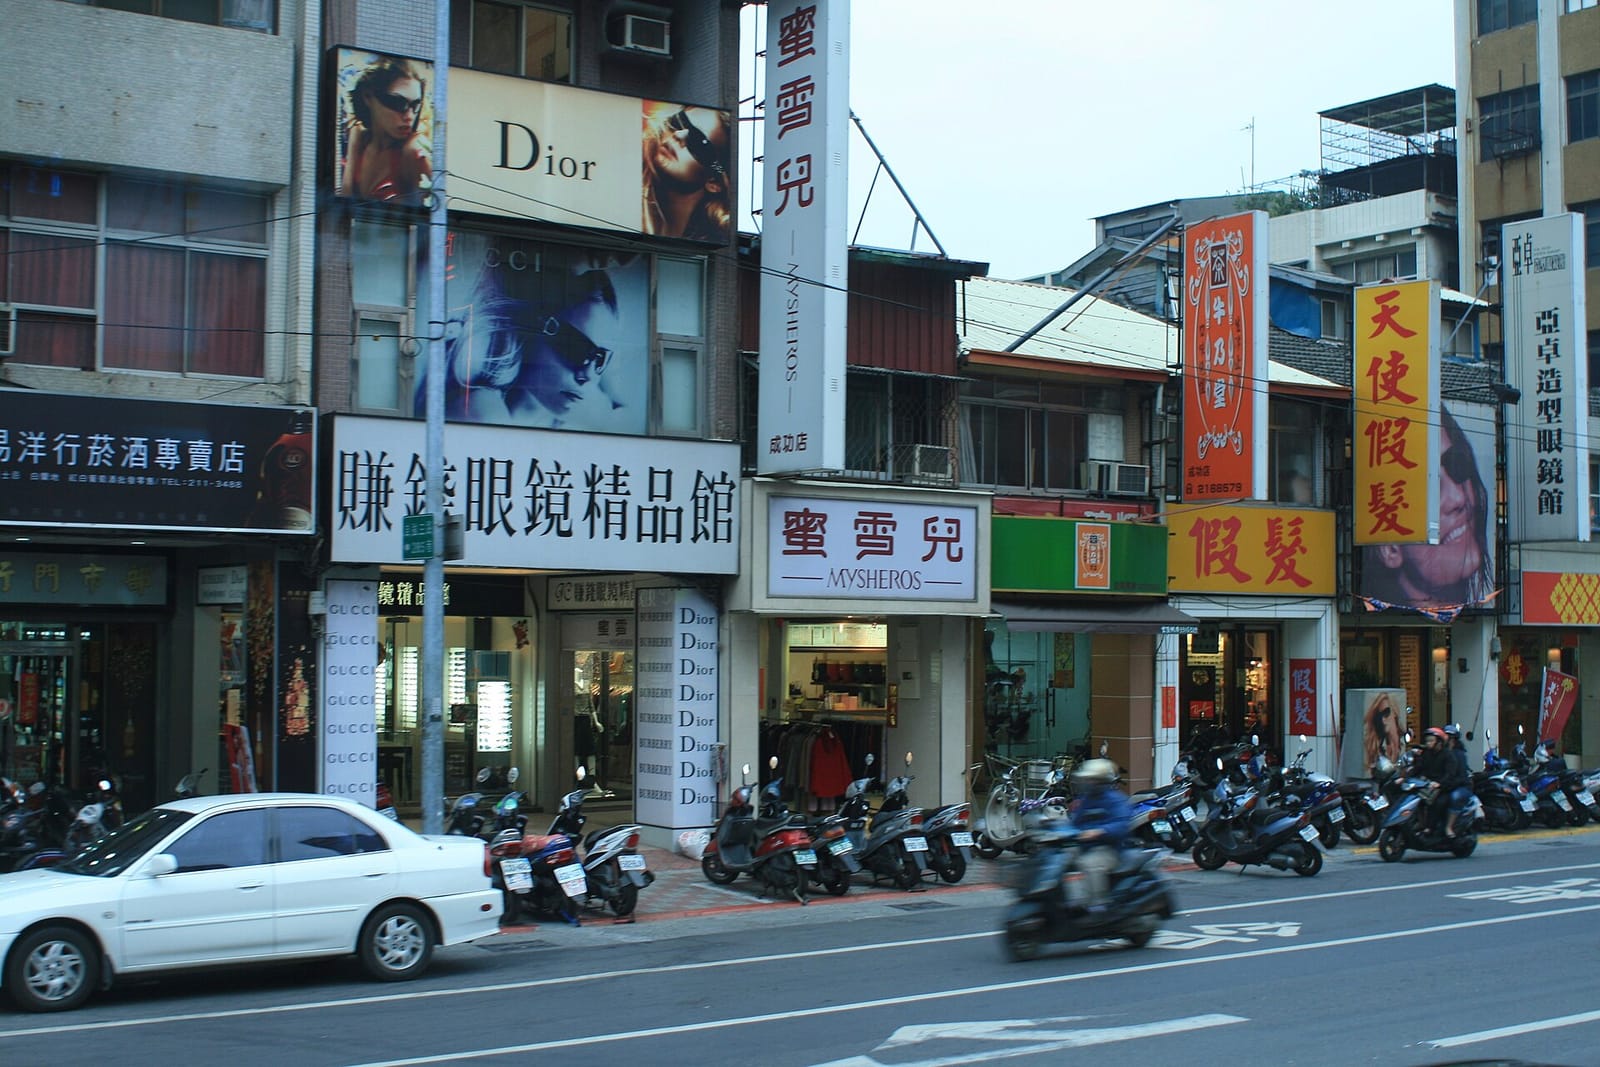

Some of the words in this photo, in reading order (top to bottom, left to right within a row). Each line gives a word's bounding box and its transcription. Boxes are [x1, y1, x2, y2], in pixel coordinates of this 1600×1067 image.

[774, 4, 818, 218] 蜜雪兒
[492, 119, 597, 182] Dior
[784, 261, 801, 383] MYSHEROS
[1364, 290, 1419, 537] 天使假髮
[1534, 306, 1565, 516] 亞卓造型眼鏡館
[769, 431, 808, 454] 成功店
[338, 449, 737, 544] 賺錢眼鏡精品館
[781, 507, 963, 563] 蜜雪兒
[1188, 515, 1313, 588] 假髮
[827, 567, 922, 591] MYSHEROS
[329, 604, 376, 616] GUCCI
[679, 607, 715, 625] Dior
[328, 634, 376, 646] GUCCI
[680, 632, 716, 650] Dior
[328, 665, 375, 676] GUCCI
[679, 658, 715, 676] Dior
[327, 695, 375, 706] GUCCI
[679, 684, 715, 702] Dior
[1292, 668, 1315, 726] 假髮
[678, 710, 715, 727] Dior
[327, 723, 375, 735] GUCCI
[326, 752, 375, 764] GUCCI
[326, 782, 374, 794] GUCCI
